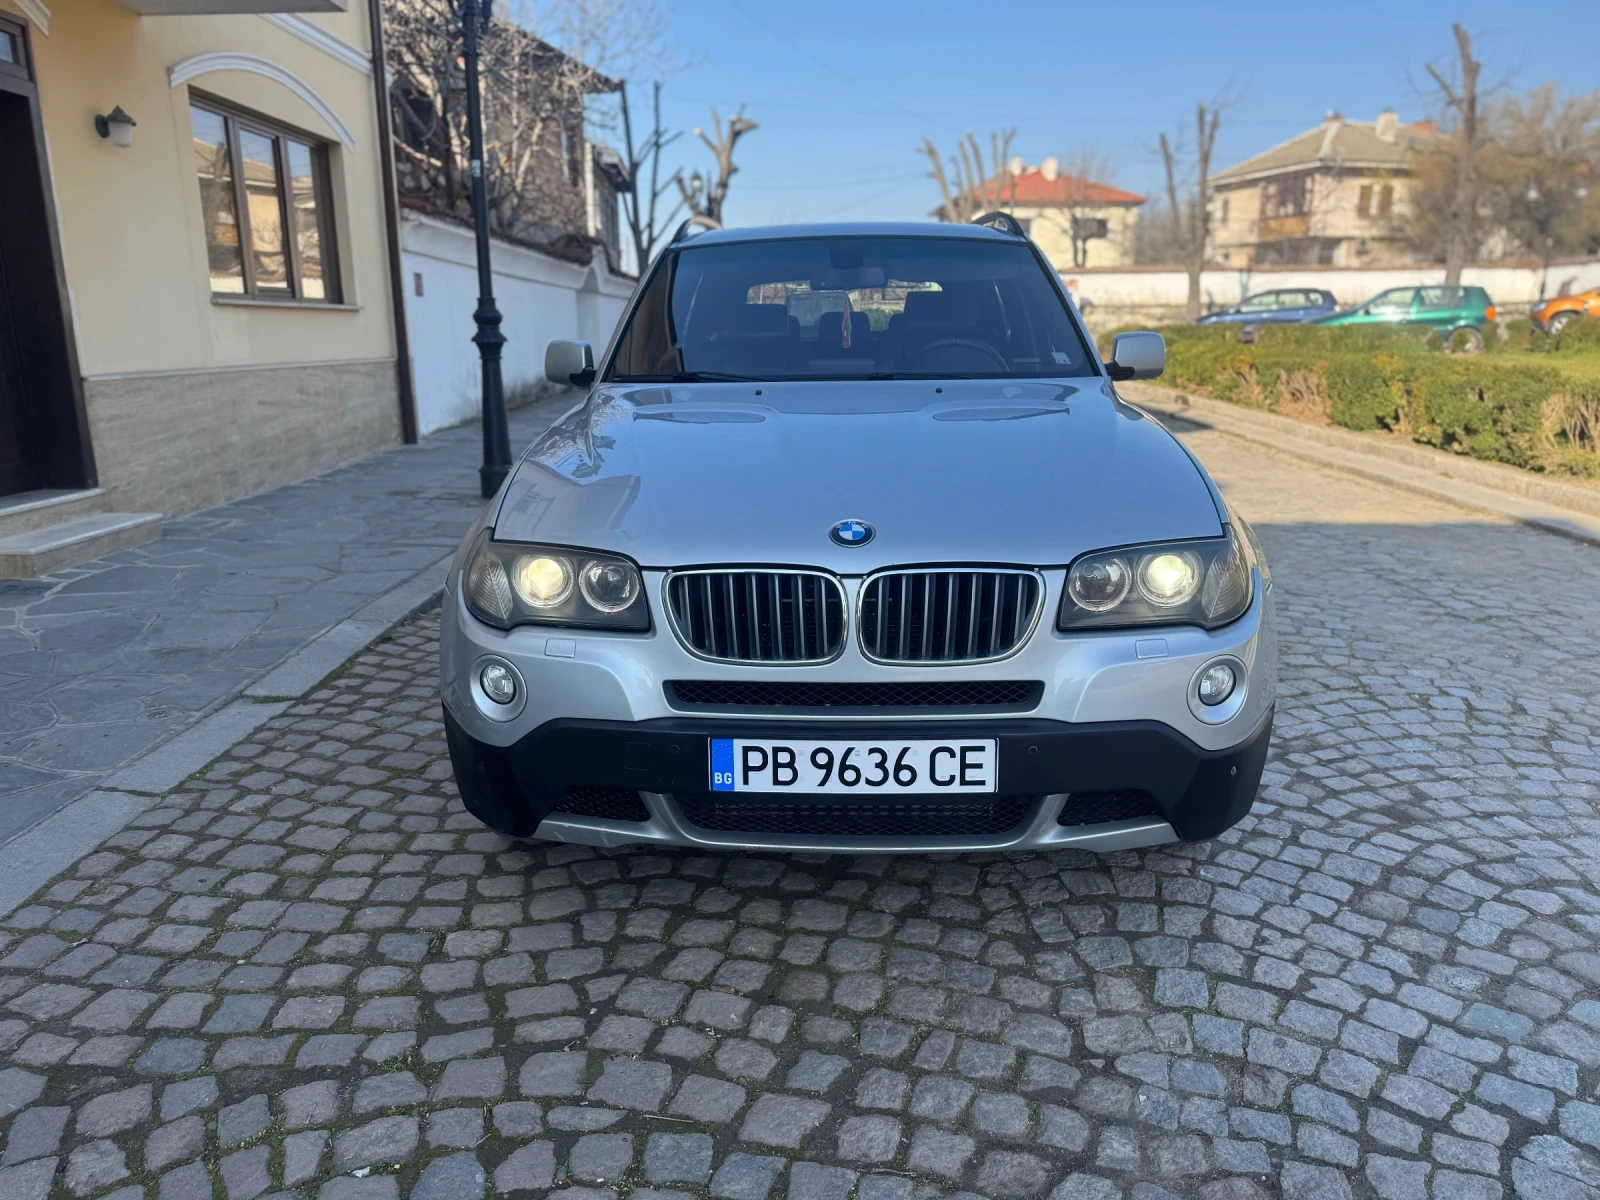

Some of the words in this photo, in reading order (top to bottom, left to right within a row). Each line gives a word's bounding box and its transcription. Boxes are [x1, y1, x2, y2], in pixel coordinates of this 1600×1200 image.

[714, 772, 732, 785] BG
[742, 746, 799, 786] PB
[810, 747, 917, 787] 9636
[929, 746, 986, 786] CE
